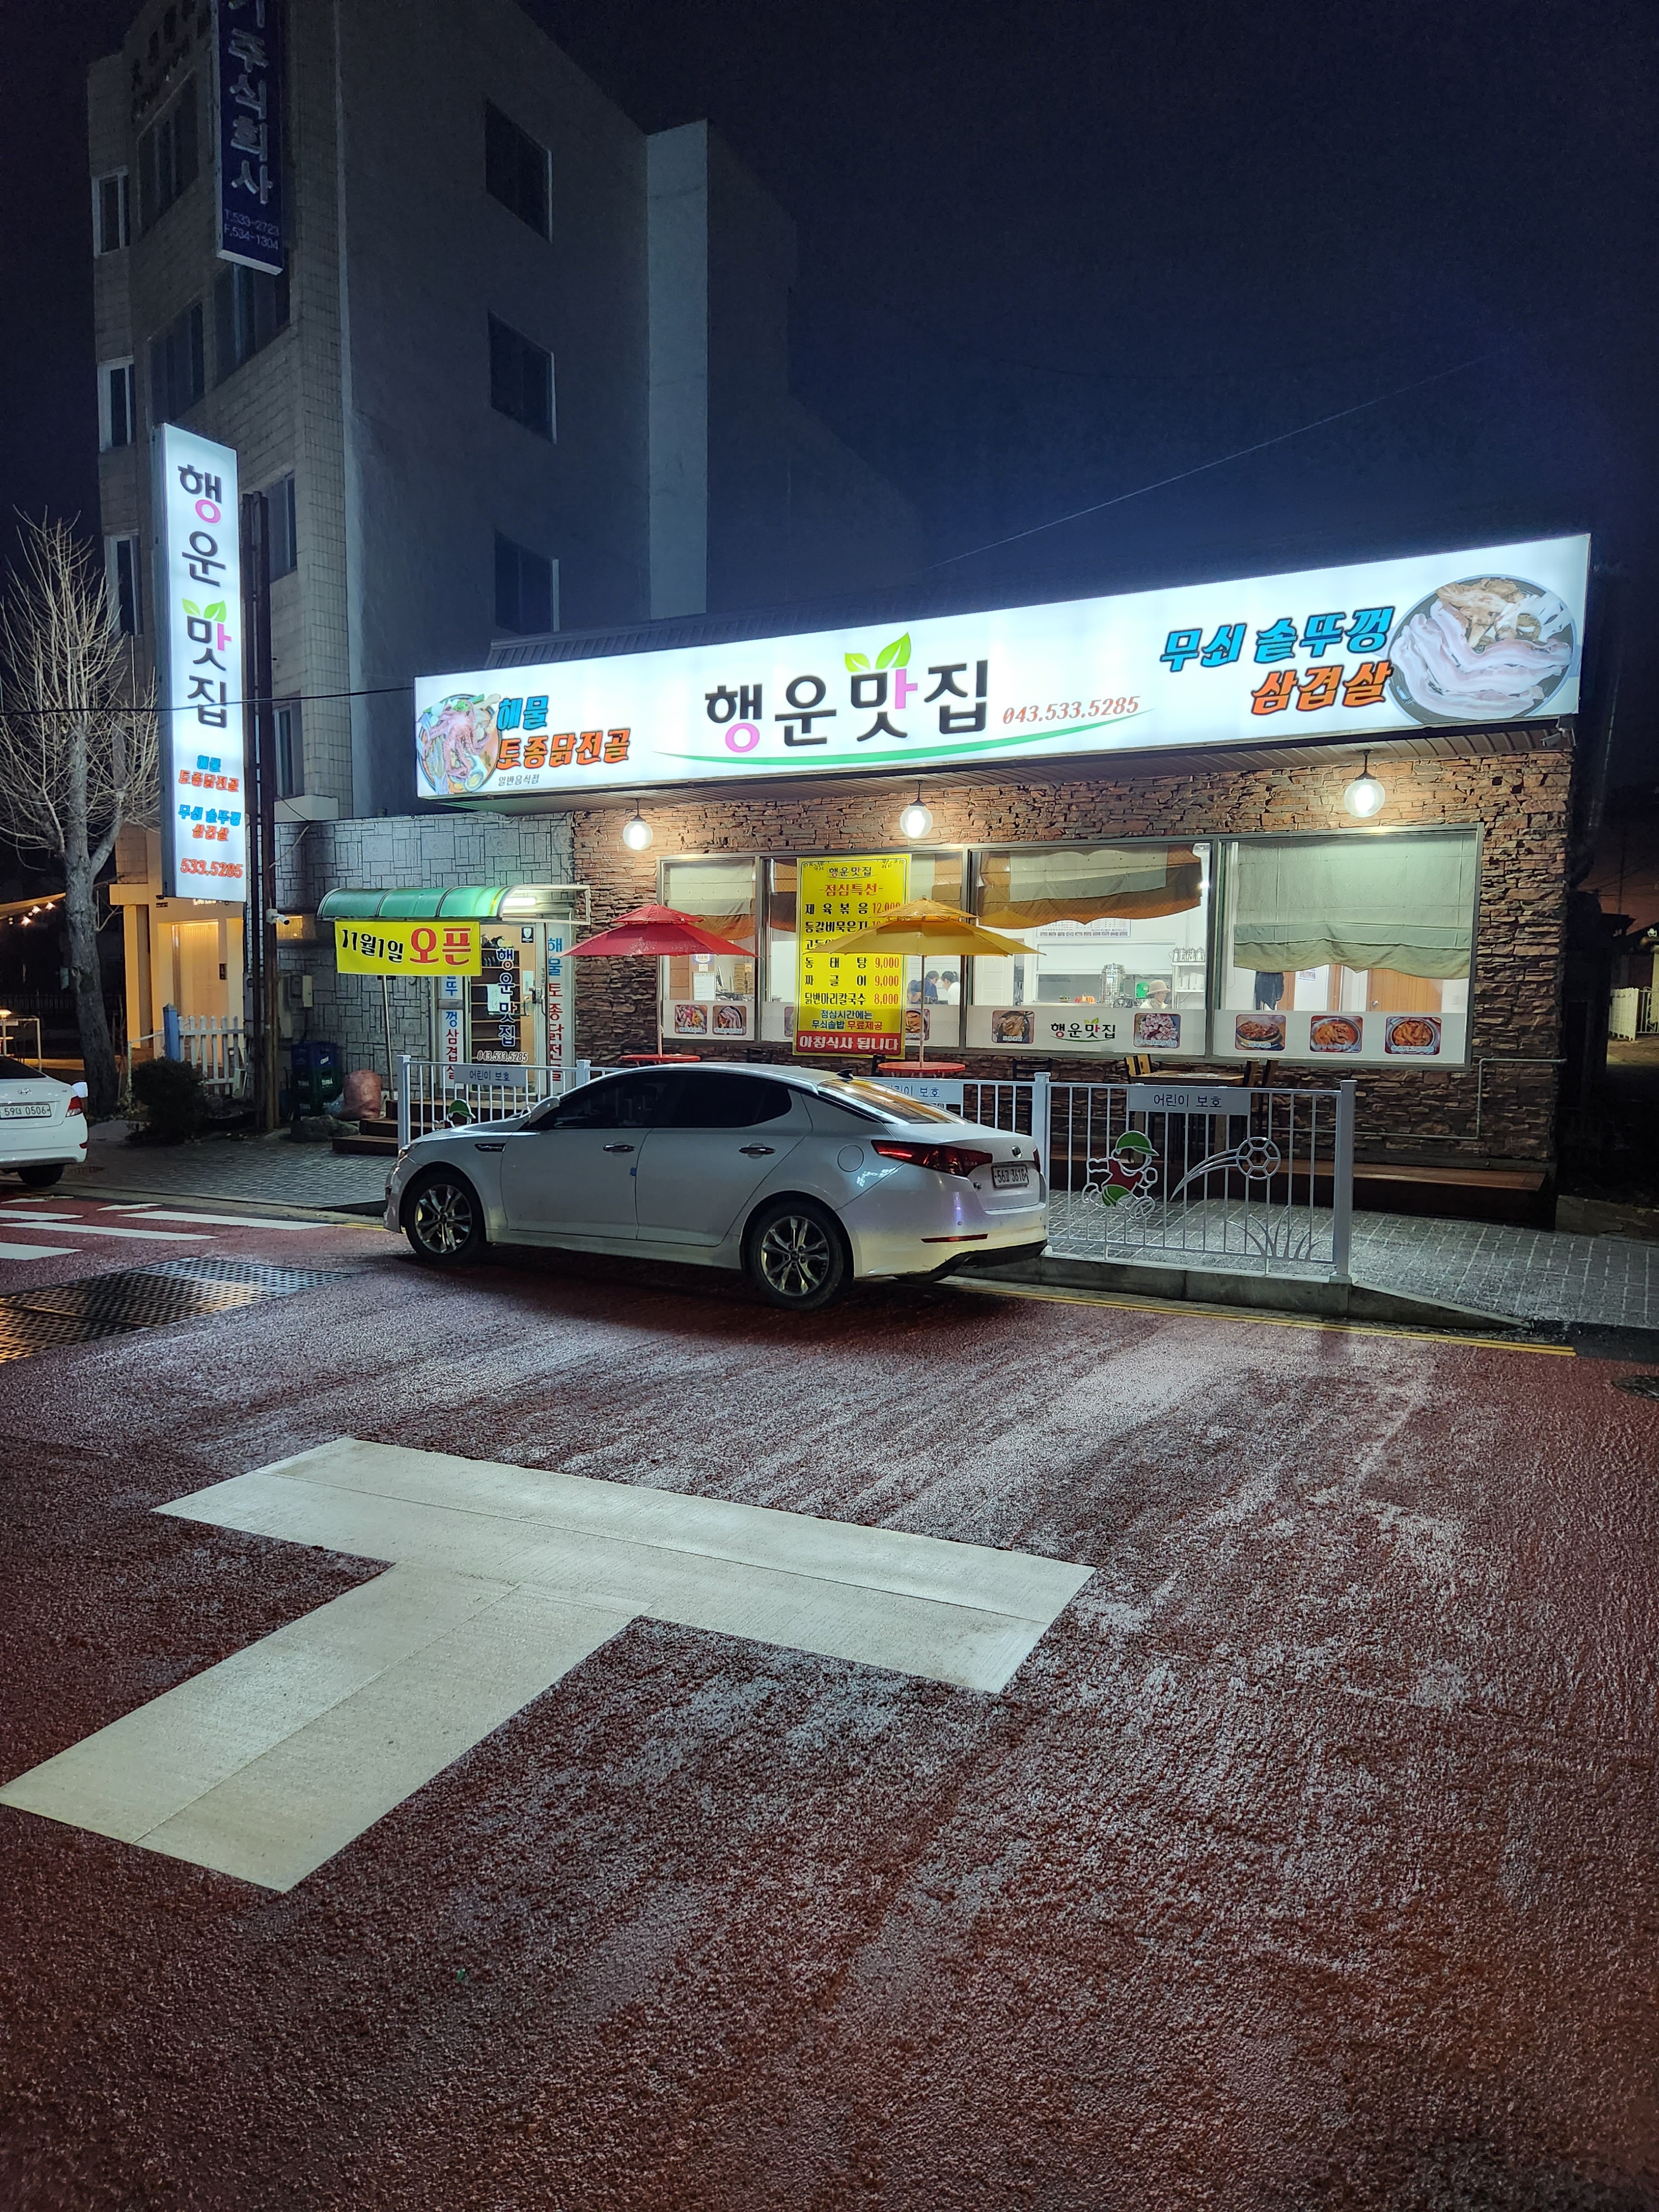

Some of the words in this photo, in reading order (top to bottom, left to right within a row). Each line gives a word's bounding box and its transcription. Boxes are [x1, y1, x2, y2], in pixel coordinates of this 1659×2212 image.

[178, 463, 232, 728] 행운맛집
[1160, 622, 1246, 672] 무쇠
[1254, 606, 1396, 664] 솥뚜껑
[1250, 659, 1395, 716] 삼겹살
[497, 695, 549, 731] 해물
[705, 658, 989, 754] 행운맛집
[1003, 696, 1141, 726] 043.533.5285
[496, 728, 631, 770] 토종닭전골
[197, 755, 221, 773] 해물
[178, 769, 239, 792] 토종닭전골
[498, 774, 540, 786] 일반음식점
[192, 823, 229, 842] 삼겹살
[180, 858, 243, 878] 533.5285
[829, 867, 872, 877] 행운맛집
[805, 921, 868, 933] 등갈비묵은지
[409, 927, 471, 966] 오픈
[874, 957, 900, 969] 9,000
[874, 975, 899, 987] 9,000
[496, 948, 517, 1047] 행운맛집
[805, 993, 867, 1005] 닭반마리칼국수
[874, 993, 899, 1005] 8,000
[821, 1010, 873, 1020] 점심시간에는
[847, 1020, 883, 1030] 무료제공
[1050, 1022, 1116, 1039] 행운맛집
[799, 1035, 854, 1050] 아침식사
[857, 1037, 899, 1051] 됩니다
[477, 1050, 529, 1062] 043.533.5285
[469, 1070, 491, 1081] 어린이
[495, 1072, 511, 1082] 보호
[919, 1087, 940, 1098] 보호
[1154, 1093, 1189, 1108] 어린이
[1196, 1095, 1222, 1108] 보호
[25, 1107, 46, 1115] 0506
